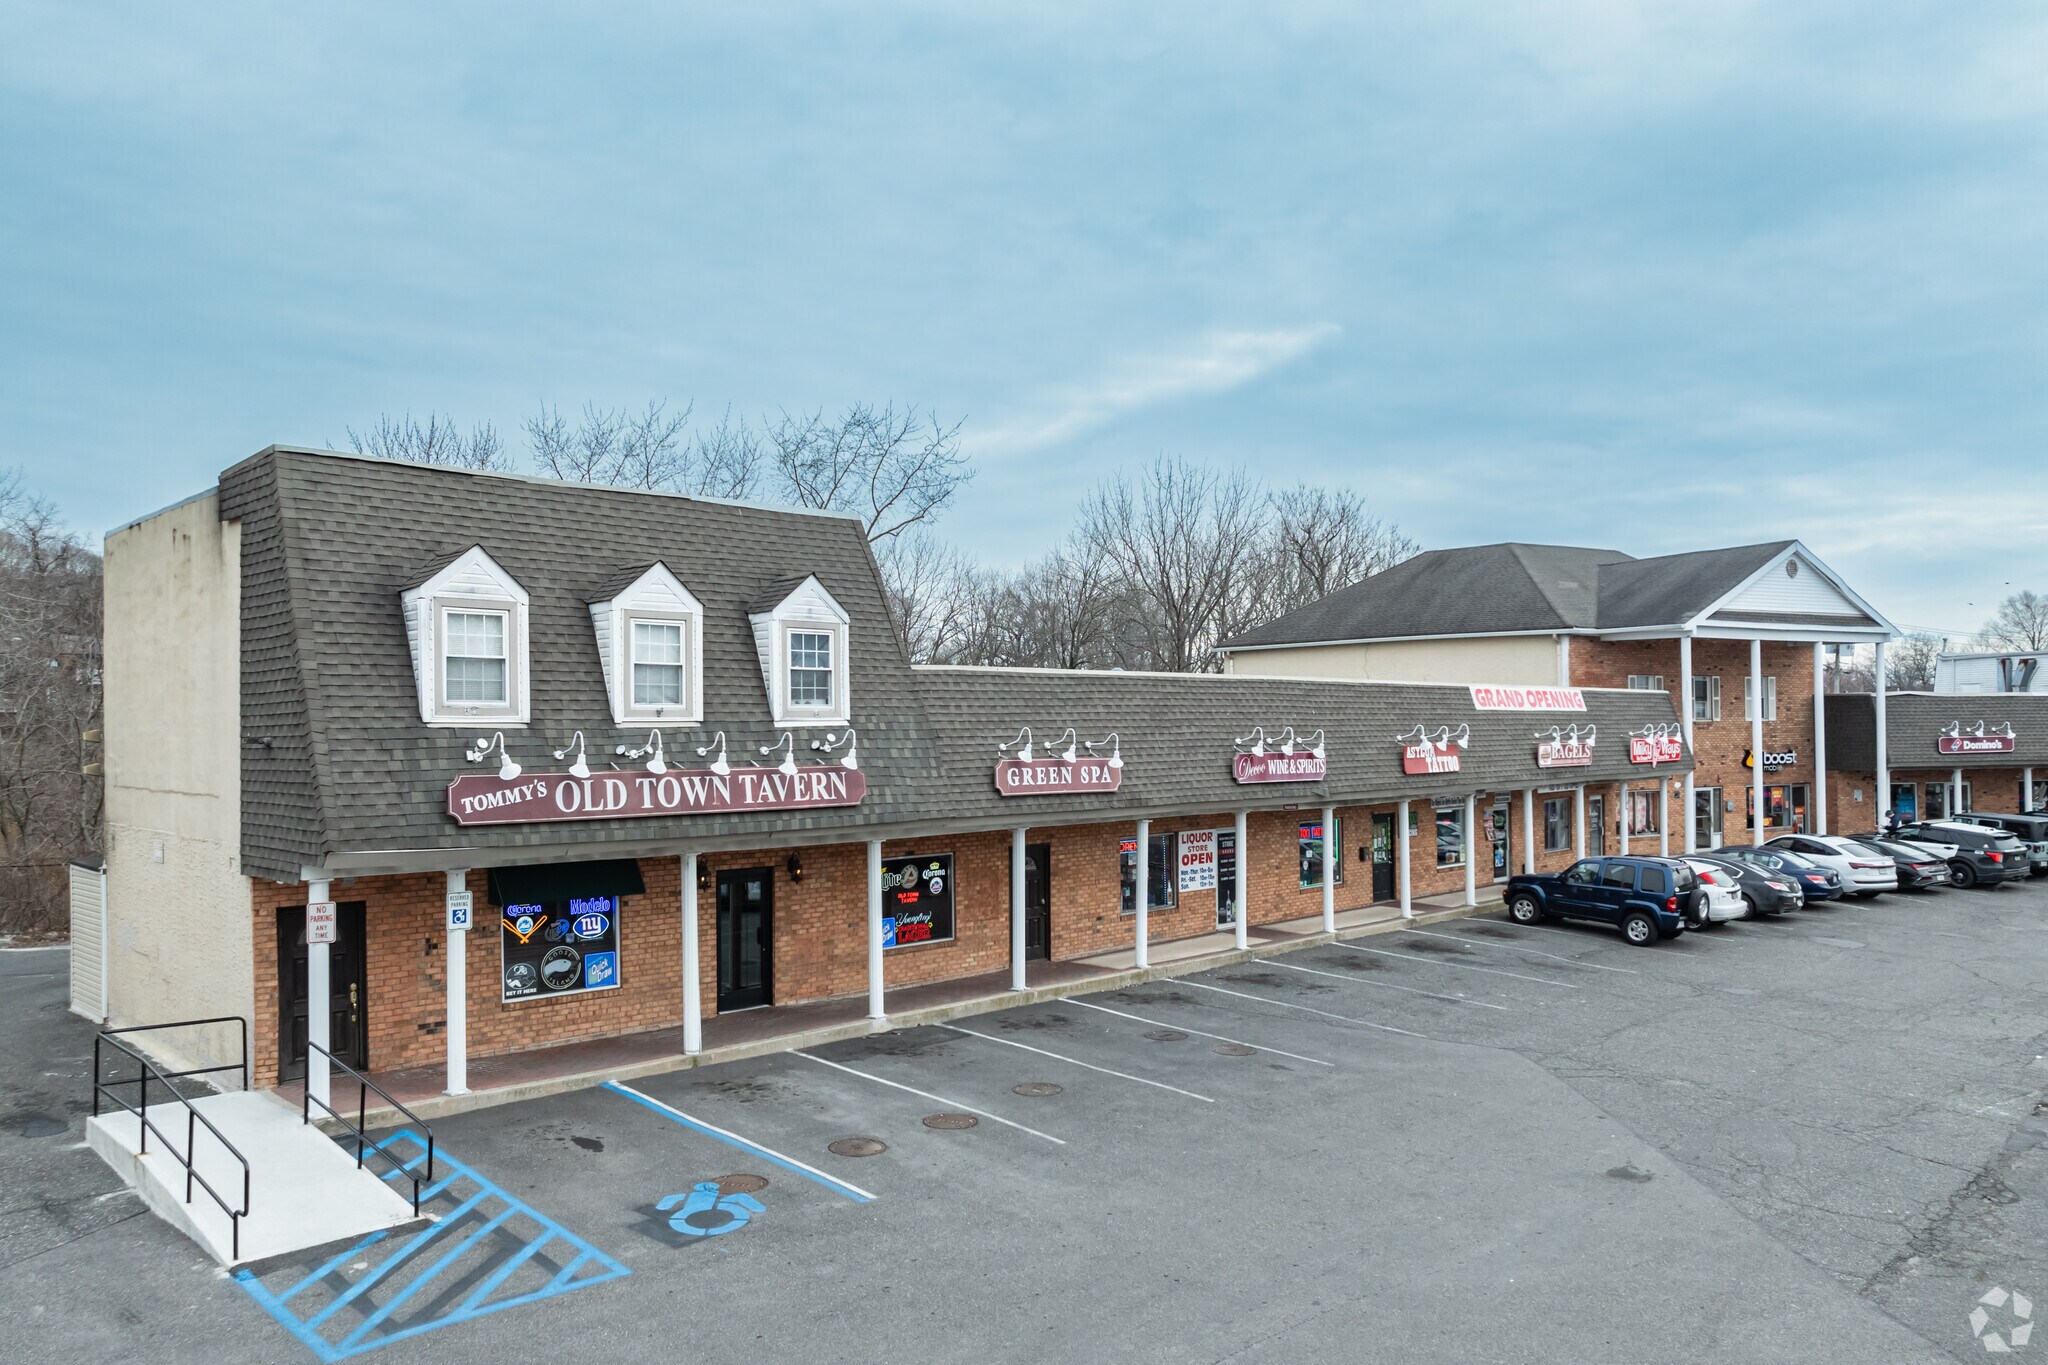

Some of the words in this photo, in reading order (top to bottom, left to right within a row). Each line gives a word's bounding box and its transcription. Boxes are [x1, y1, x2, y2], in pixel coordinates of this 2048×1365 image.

[1475, 688, 1525, 708] GRAND
[1525, 690, 1584, 709] OPENING
[1552, 744, 1591, 759] BAGELS
[1633, 741, 1653, 759] Milky
[1660, 742, 1680, 758] Ways
[1963, 739, 2002, 750] Domino's
[1426, 755, 1460, 773] TATTOO
[1763, 751, 1797, 764] boost
[1268, 759, 1289, 775] WINE
[1289, 759, 1297, 774] &
[1297, 758, 1325, 774] SPIRITS
[1007, 766, 1073, 786] GREEN
[1080, 765, 1112, 783] SPA
[555, 778, 628, 813] OLD
[635, 774, 731, 809] TOWN
[738, 771, 847, 804] TAVERN
[1181, 831, 1213, 845] LIQUOR
[1187, 844, 1208, 853] STORE
[1181, 852, 1214, 867] OPEN
[922, 869, 945, 880] Corona
[507, 904, 542, 917] Corona
[570, 897, 611, 915] Modelo
[310, 914, 333, 922] PARKING
[895, 911, 932, 927] Yuengling
[548, 949, 572, 961] GOOSE
[591, 958, 609, 975] Quick
[549, 973, 574, 985] ISLAND
[597, 967, 612, 983] Draw
